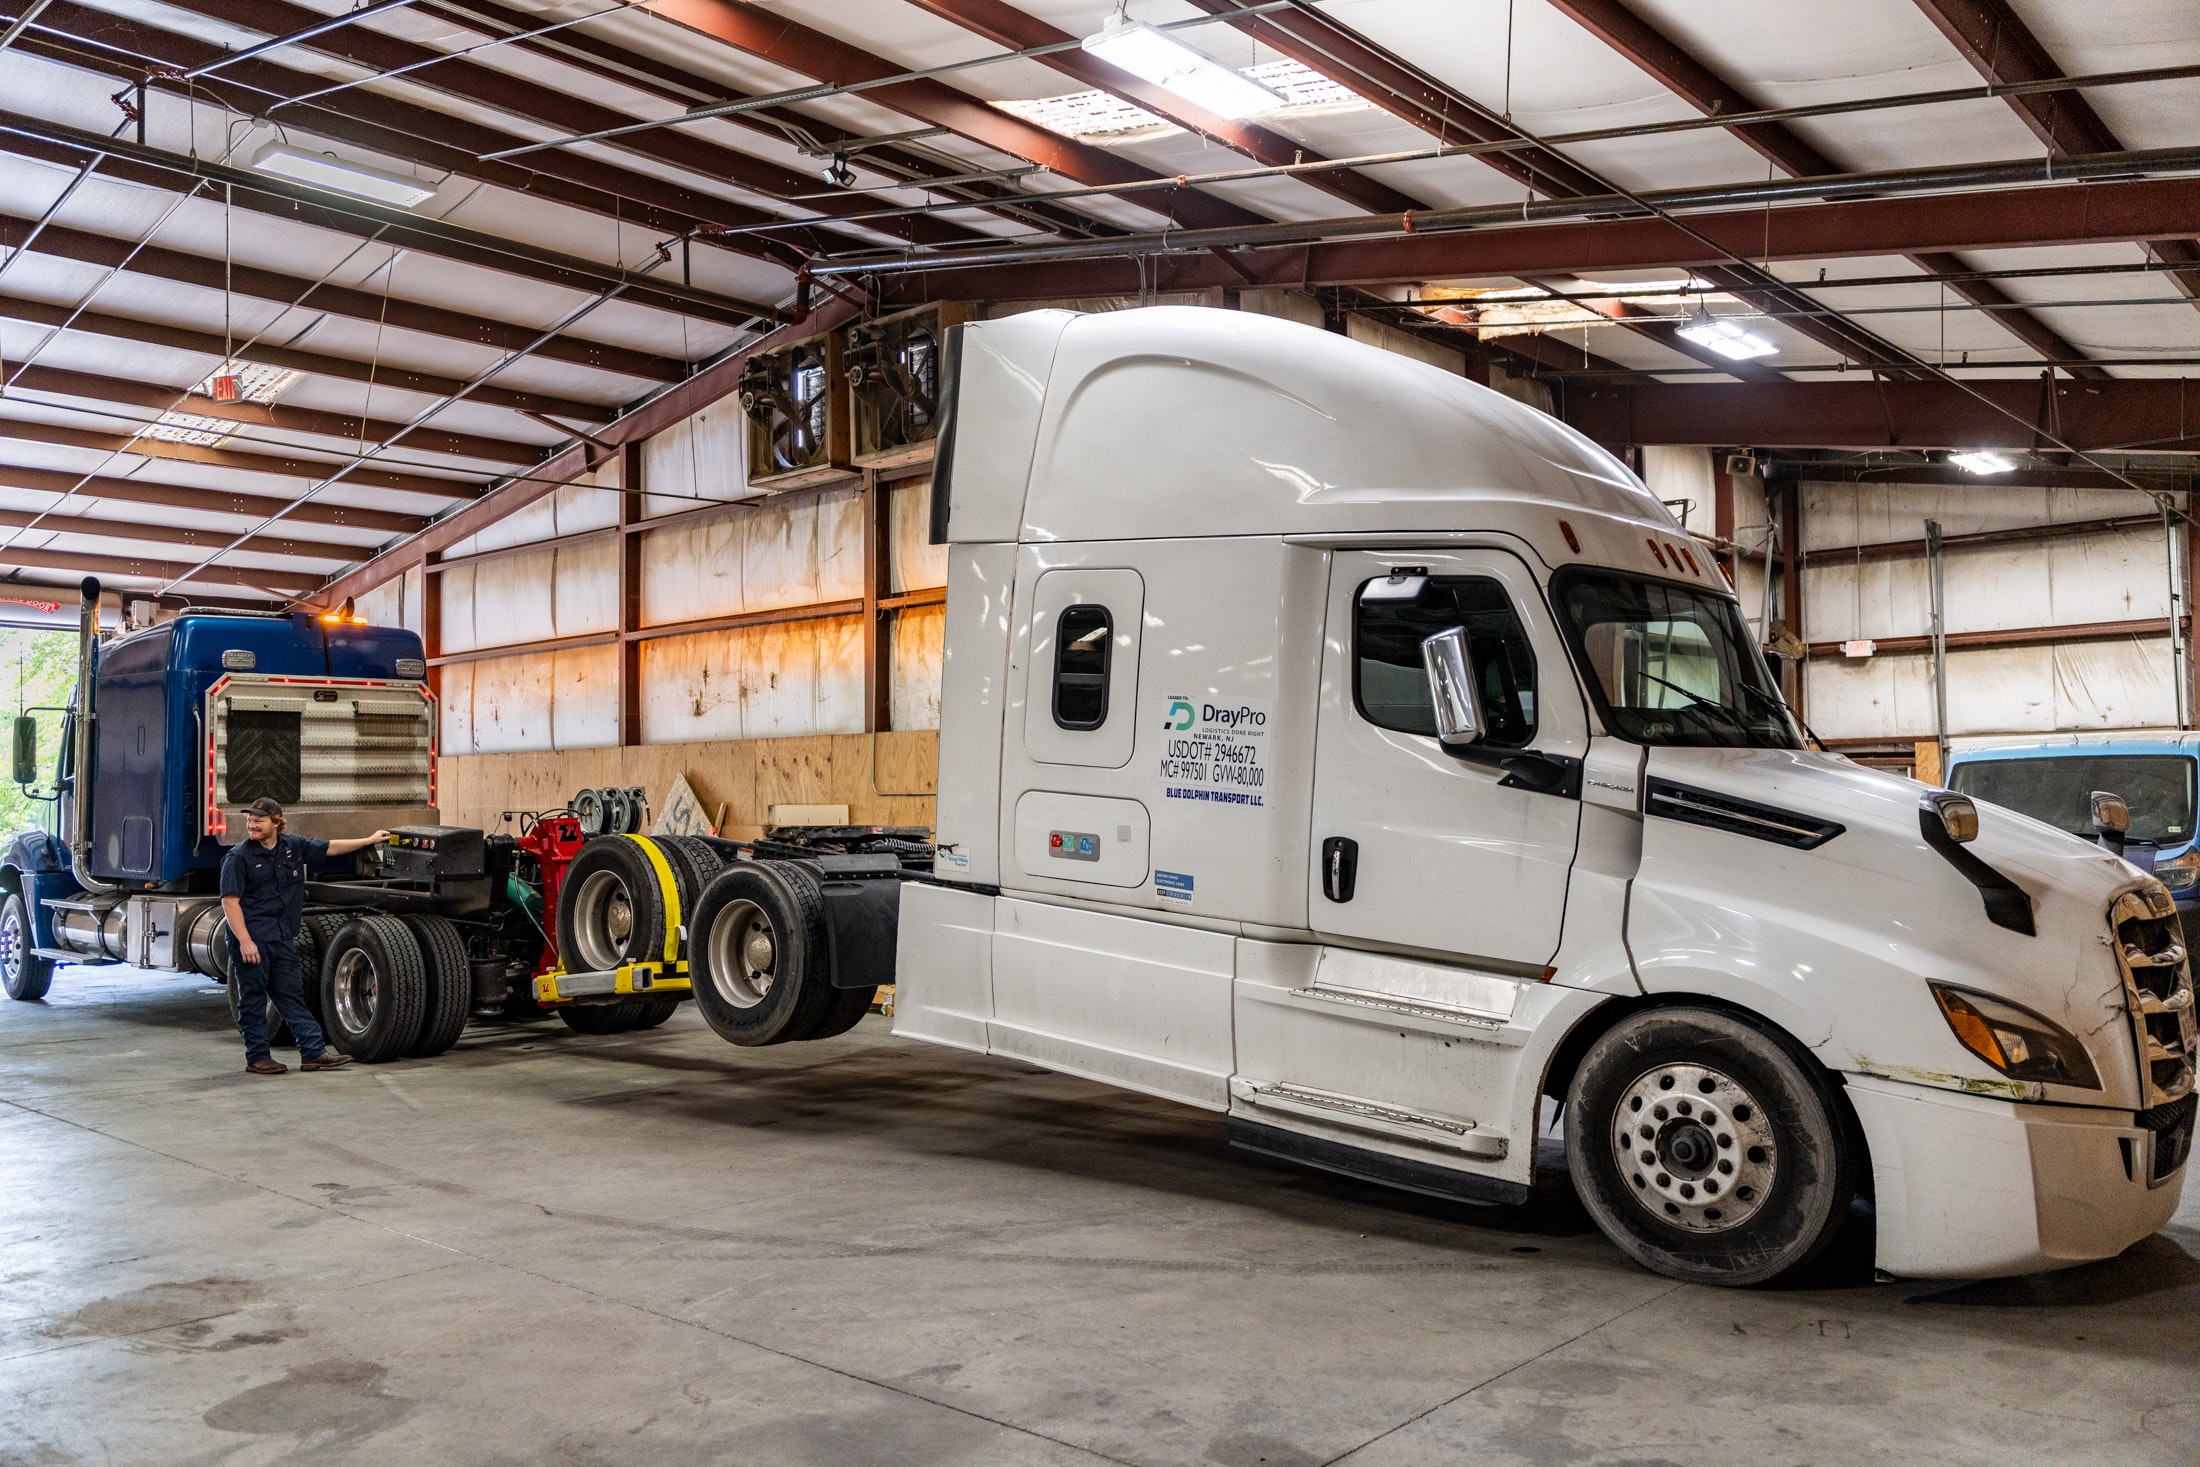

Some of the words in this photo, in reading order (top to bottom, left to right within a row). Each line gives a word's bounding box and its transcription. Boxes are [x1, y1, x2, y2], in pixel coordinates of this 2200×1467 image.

[216, 375, 236, 401] EXIT
[1202, 704, 1266, 728] DrayPro
[1193, 733, 1224, 742] NEWARK,
[1168, 739, 1212, 761] USDOT#
[1214, 743, 1256, 764] 2946672
[1160, 760, 1179, 778] MC#
[1181, 761, 1207, 781] 997501
[1212, 764, 1264, 787] GVW-80,000
[1166, 788, 1182, 799] BLUE
[1182, 789, 1210, 801] DOLPHIN
[1211, 791, 1249, 805] TRANSPORT
[1250, 795, 1264, 806] LLC.
